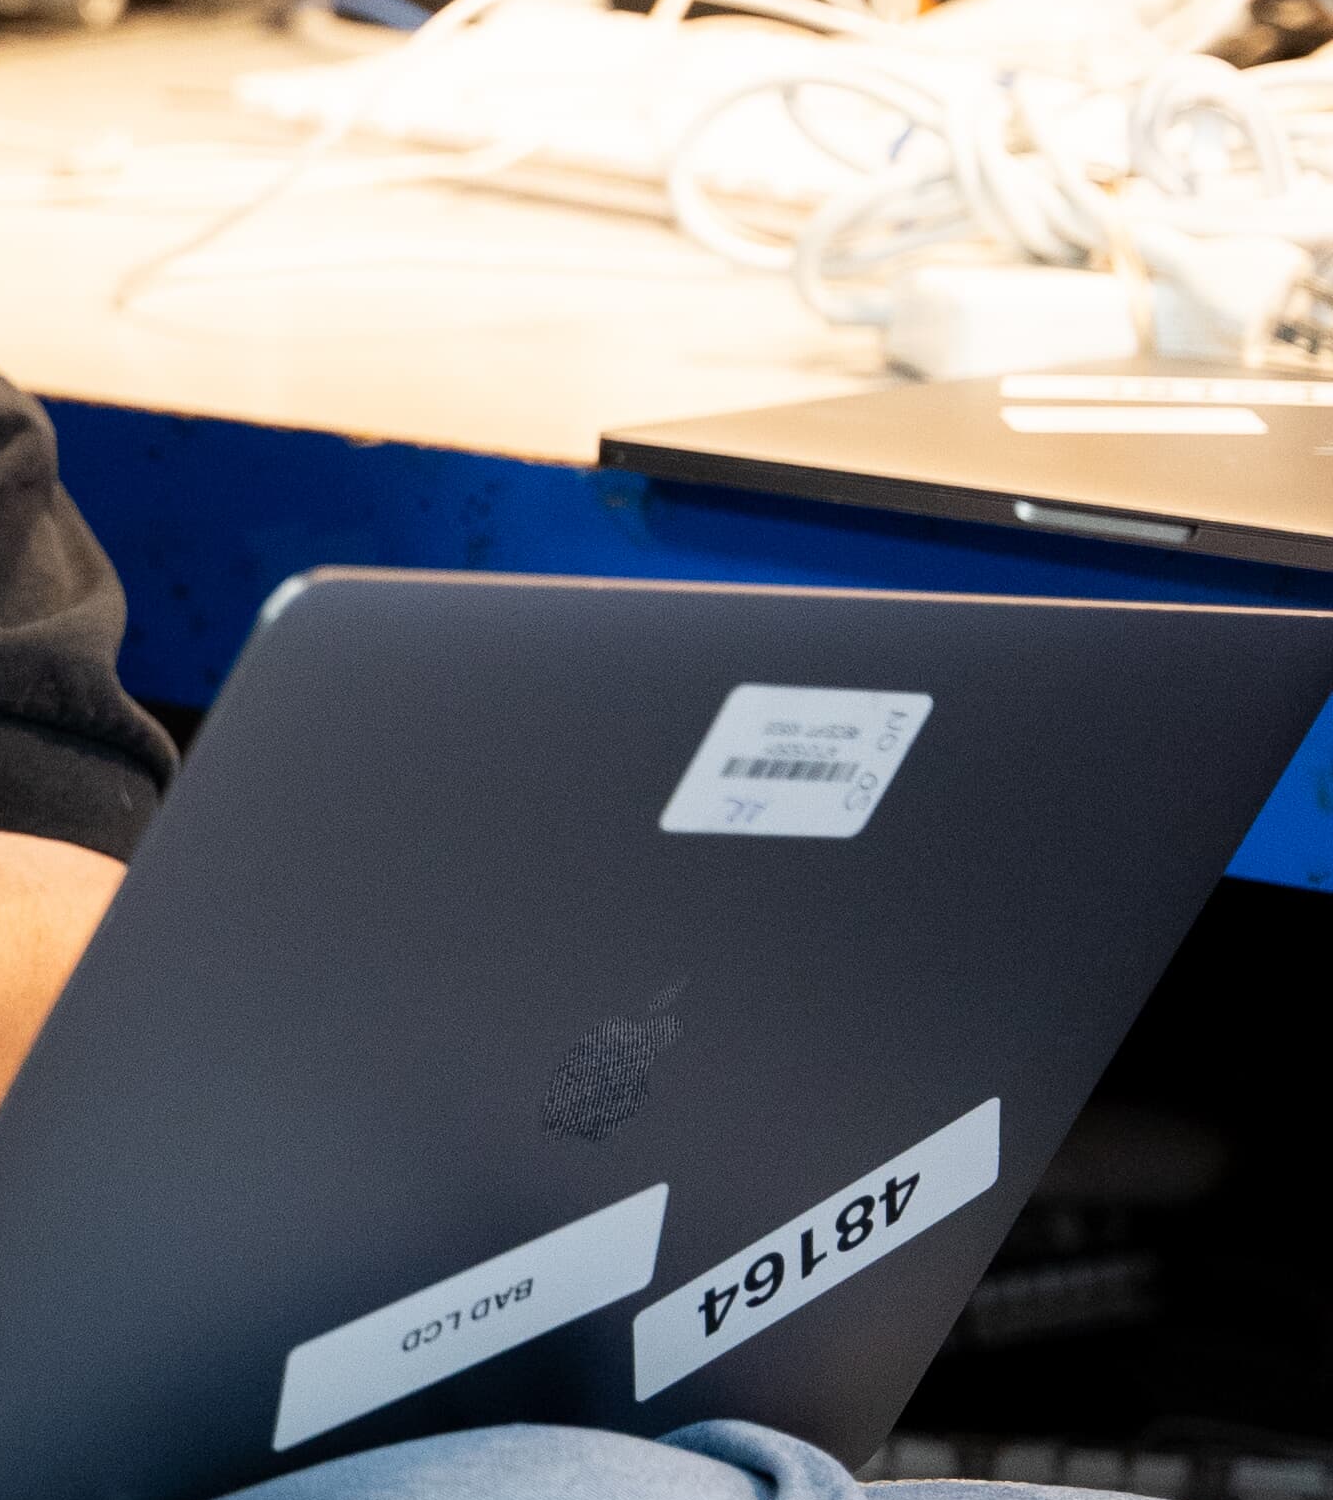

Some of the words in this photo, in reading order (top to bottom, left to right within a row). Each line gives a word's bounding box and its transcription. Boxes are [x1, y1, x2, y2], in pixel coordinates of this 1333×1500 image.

[698, 1171, 922, 1338] 48164
[470, 1278, 533, 1321] BAD
[401, 1309, 461, 1353] LCD
